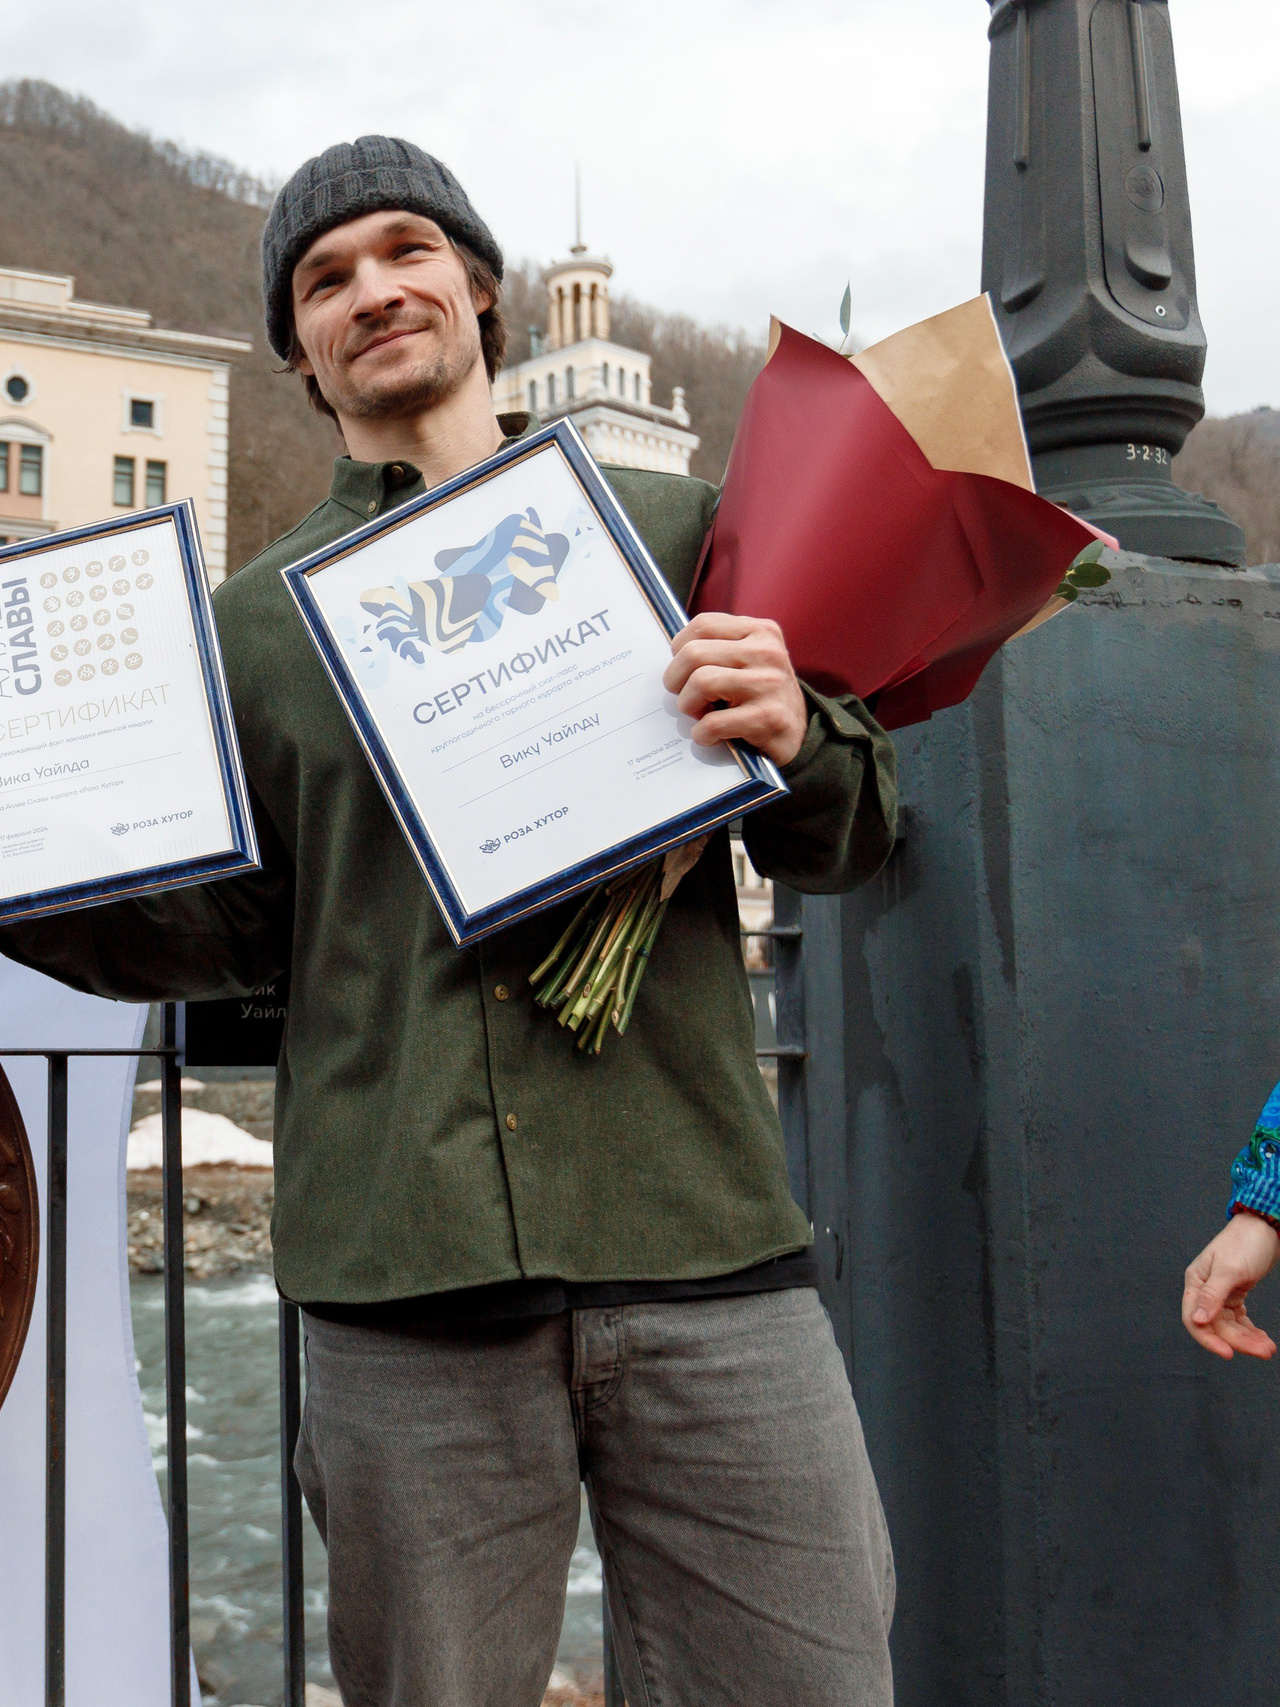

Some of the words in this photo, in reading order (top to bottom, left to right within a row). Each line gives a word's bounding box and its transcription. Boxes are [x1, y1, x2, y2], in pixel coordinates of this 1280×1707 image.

[2, 577, 42, 696] СЛАВЫ
[412, 608, 612, 724] СЕРТИФИКАТ
[430, 714, 502, 754] круглогодичного
[502, 697, 537, 719] горного
[538, 678, 573, 700] курорта
[574, 664, 600, 681] «Роза
[602, 649, 633, 668] Хутор»
[472, 710, 484, 721] на
[485, 684, 537, 715] бессрочный
[538, 664, 579, 688] ски-пасс
[48, 738, 64, 748] факт
[66, 732, 96, 743] закладки
[97, 724, 127, 736] именной
[128, 719, 154, 729] медали
[500, 742, 540, 768] Вику
[541, 713, 600, 746] Уайлду
[34, 759, 90, 779] Уайлда
[6, 800, 26, 810] Аллее
[27, 796, 49, 805] Славы
[50, 790, 78, 800] курорта
[79, 784, 99, 794] «Роза
[133, 818, 159, 830] РОЗА
[161, 810, 194, 824] ХУТОР
[504, 825, 533, 843] РОЗА
[534, 806, 569, 829] ХУТОР
[241, 1004, 286, 1019] Уайл
